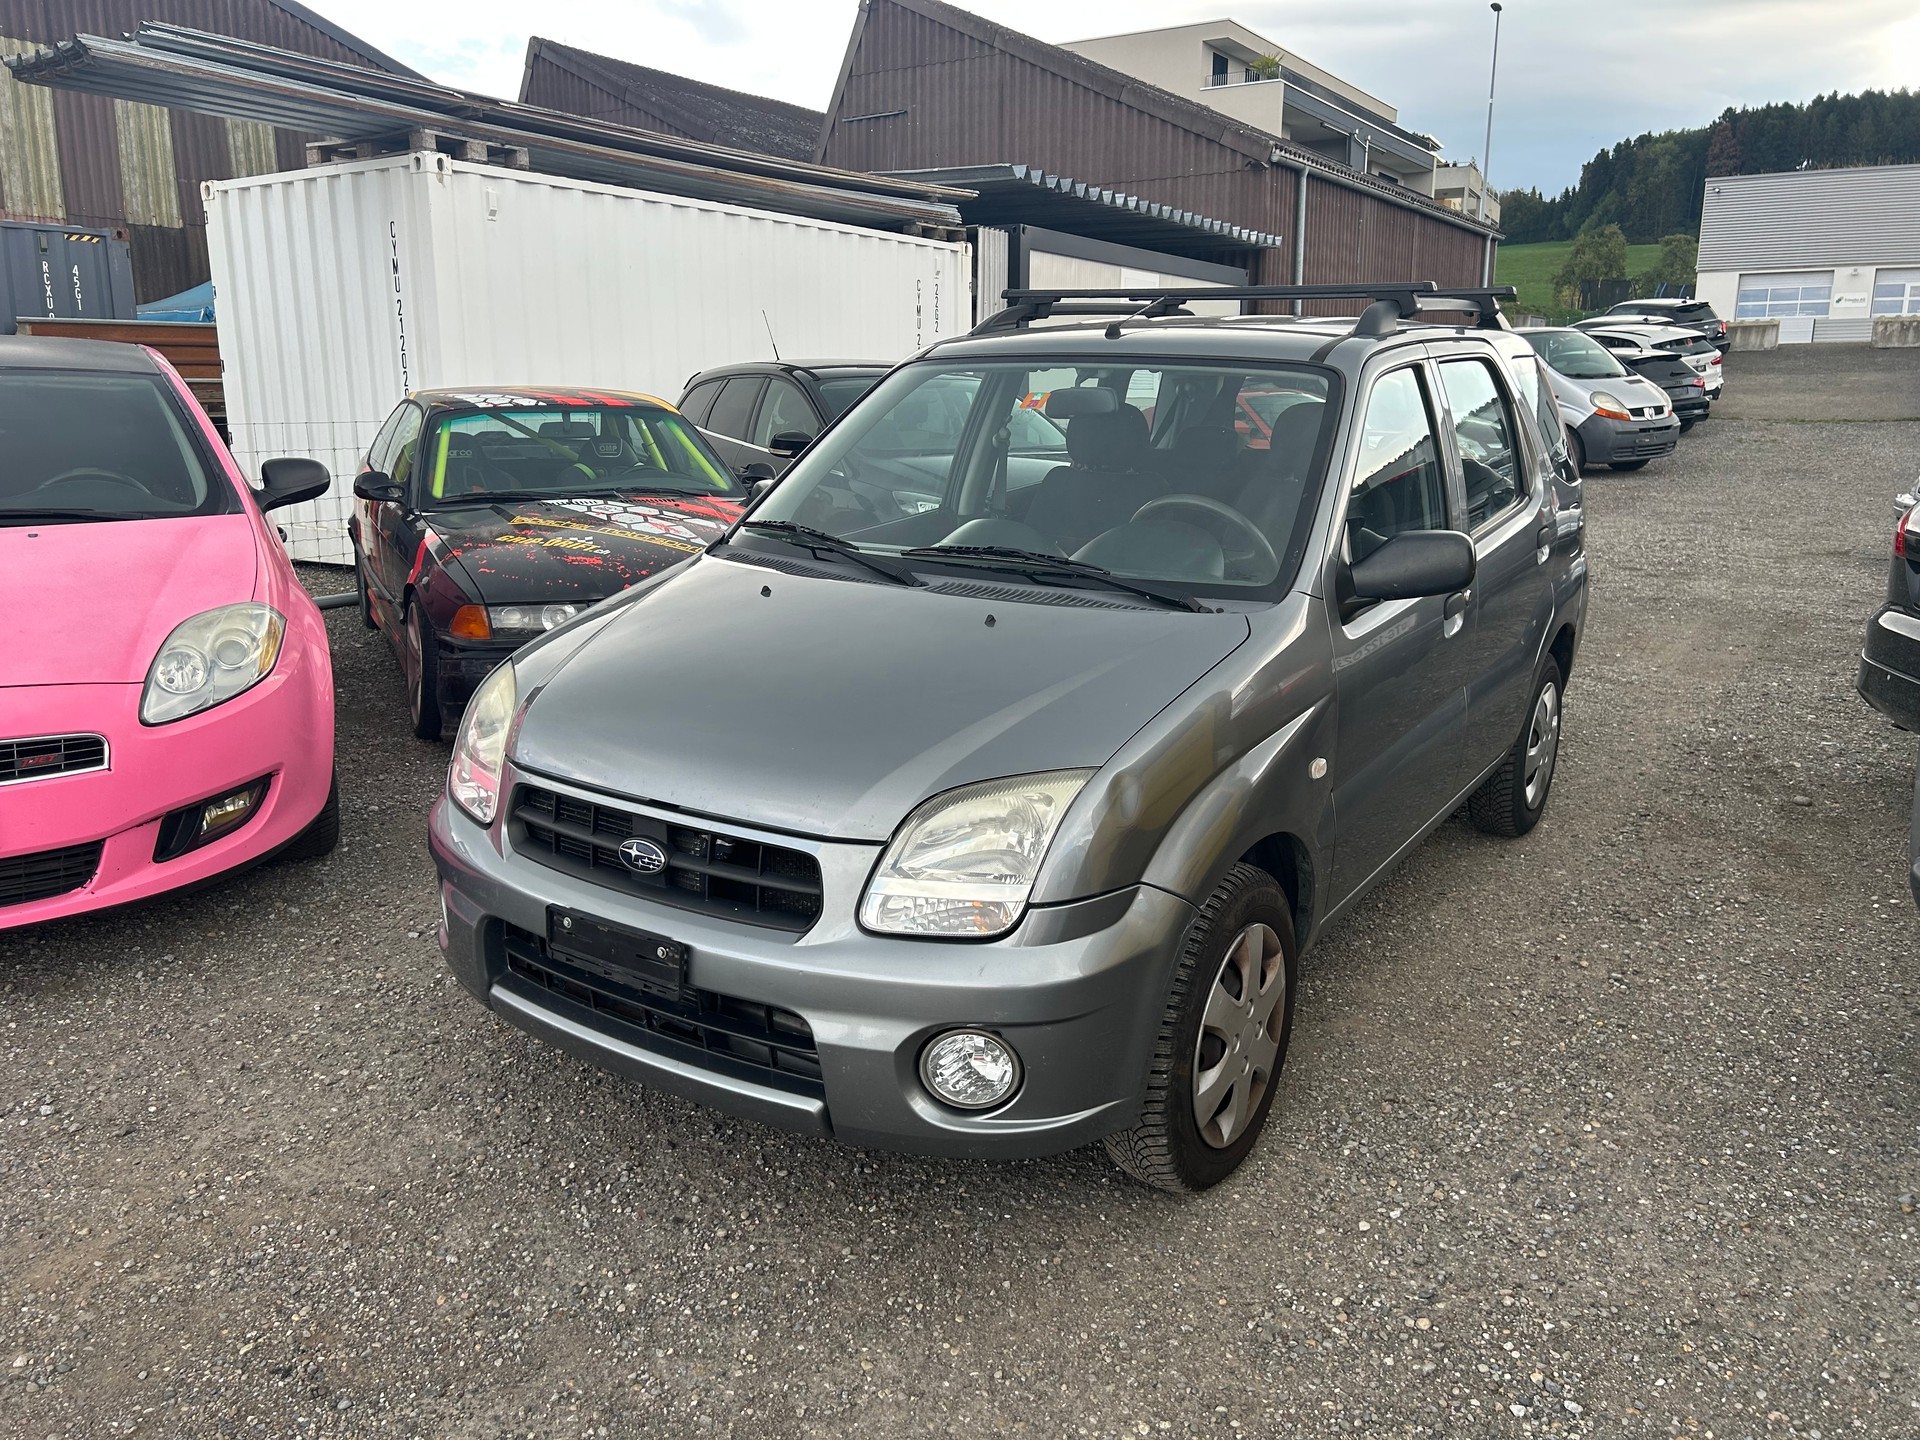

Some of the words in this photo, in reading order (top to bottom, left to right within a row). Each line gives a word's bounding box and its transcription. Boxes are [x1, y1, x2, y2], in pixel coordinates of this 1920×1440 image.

[389, 220, 401, 293] CYMU
[42, 260, 54, 309] RCXU
[72, 264, 82, 311] 45G1
